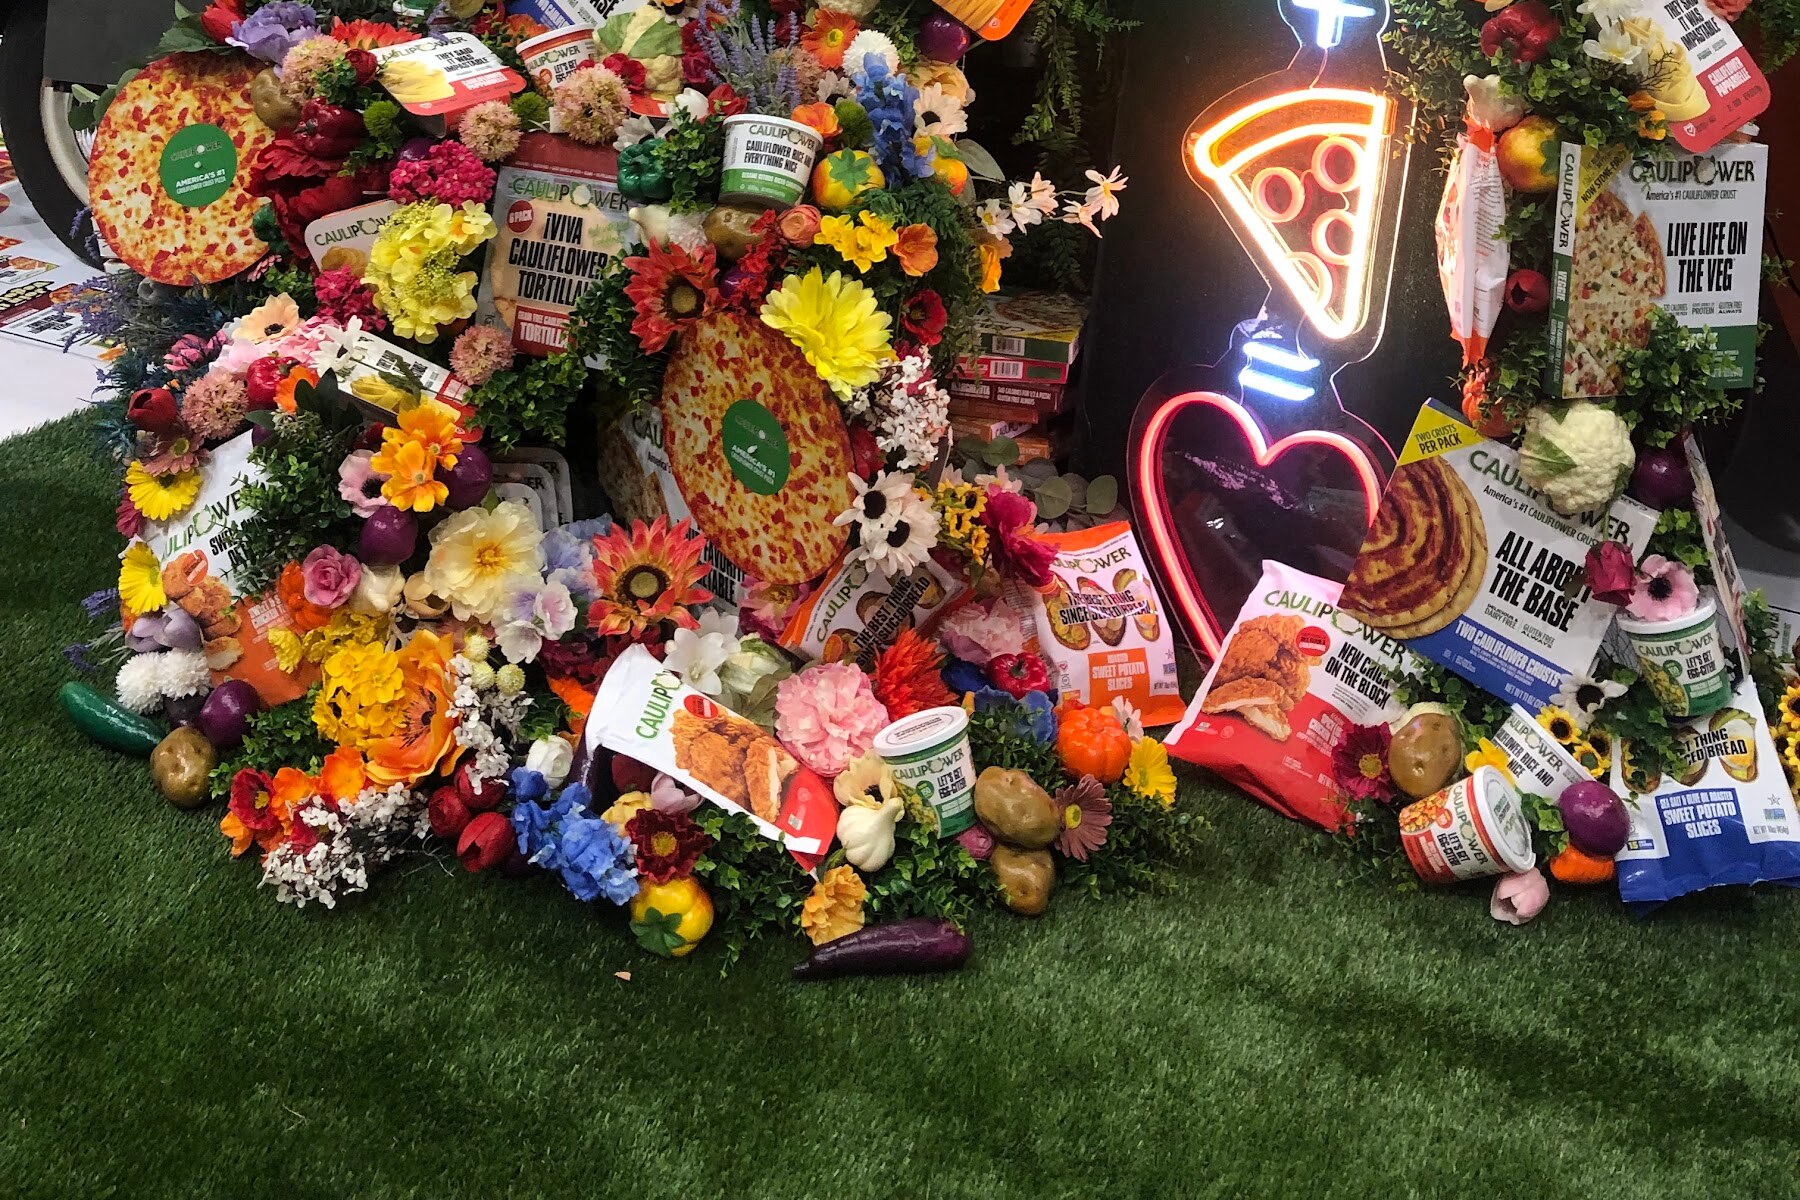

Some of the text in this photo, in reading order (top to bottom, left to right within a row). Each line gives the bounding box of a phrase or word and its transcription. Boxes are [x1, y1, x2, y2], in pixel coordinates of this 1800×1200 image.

[1677, 6, 1706, 32] IT WAS
[1680, 16, 1722, 52] IMPASTABLE
[435, 47, 474, 61] THEY SAID
[443, 57, 490, 73] IMPASTABLE
[454, 53, 475, 65] WAS
[749, 124, 815, 151] CAULIPOWER
[743, 152, 798, 174] EVERYTHING NICE
[745, 140, 804, 164] CAULIFLOWER RICE
[175, 168, 226, 188] AMERICA'S #1
[512, 176, 630, 212] CAULIPOWER
[1558, 152, 1575, 249] CAULIPOWER
[1580, 185, 1598, 205] NOW
[1645, 189, 1737, 201] America's #1 CAULIFLOWER CRUST
[508, 210, 533, 224] 6 PACK
[1666, 221, 1748, 258] LIVE LIFE ON
[508, 238, 609, 281] CAULIFLOWER
[1556, 270, 1569, 302] VEGGIE
[1677, 257, 1735, 293] THE VEG
[1691, 307, 1715, 316] PROTEIN
[1414, 424, 1458, 444] TWO CRUSTS
[1418, 432, 1462, 455] PER PACK
[1483, 485, 1577, 538] America's #1 CAULIFLOWER
[1495, 531, 1535, 573] ALL
[879, 575, 931, 642] SLICED BREAD
[1106, 589, 1136, 605] THING
[1488, 565, 1580, 634] THE BASE
[852, 575, 914, 649] THE BEST THING
[1059, 606, 1090, 626] SINCE
[1263, 589, 1408, 664] CAULIPOWER
[1484, 607, 1556, 645] DAIRY FREE GLUTEN FREE
[1337, 641, 1362, 666] NEW
[1455, 619, 1476, 642] TWO
[1473, 629, 1529, 671] CAULIFLOWER
[1525, 660, 1562, 688] CRUSTS
[1638, 632, 1714, 657] CAULIPOWER
[1092, 661, 1146, 679] SWEET POTATO
[1685, 650, 1713, 669] LET'S GET
[1324, 655, 1392, 710] ON THE BLOCK
[1693, 727, 1730, 747] THING
[1704, 739, 1748, 759] BREAD
[892, 747, 965, 780] CAULIPOWER
[1519, 751, 1556, 788] RICE AND
[936, 766, 963, 787] LET'S GET
[1451, 783, 1489, 866] CAULIPOWER
[1663, 801, 1737, 826] SWEET POTATO
[1684, 818, 1722, 840] SLICES
[1448, 831, 1464, 853] LET'S
